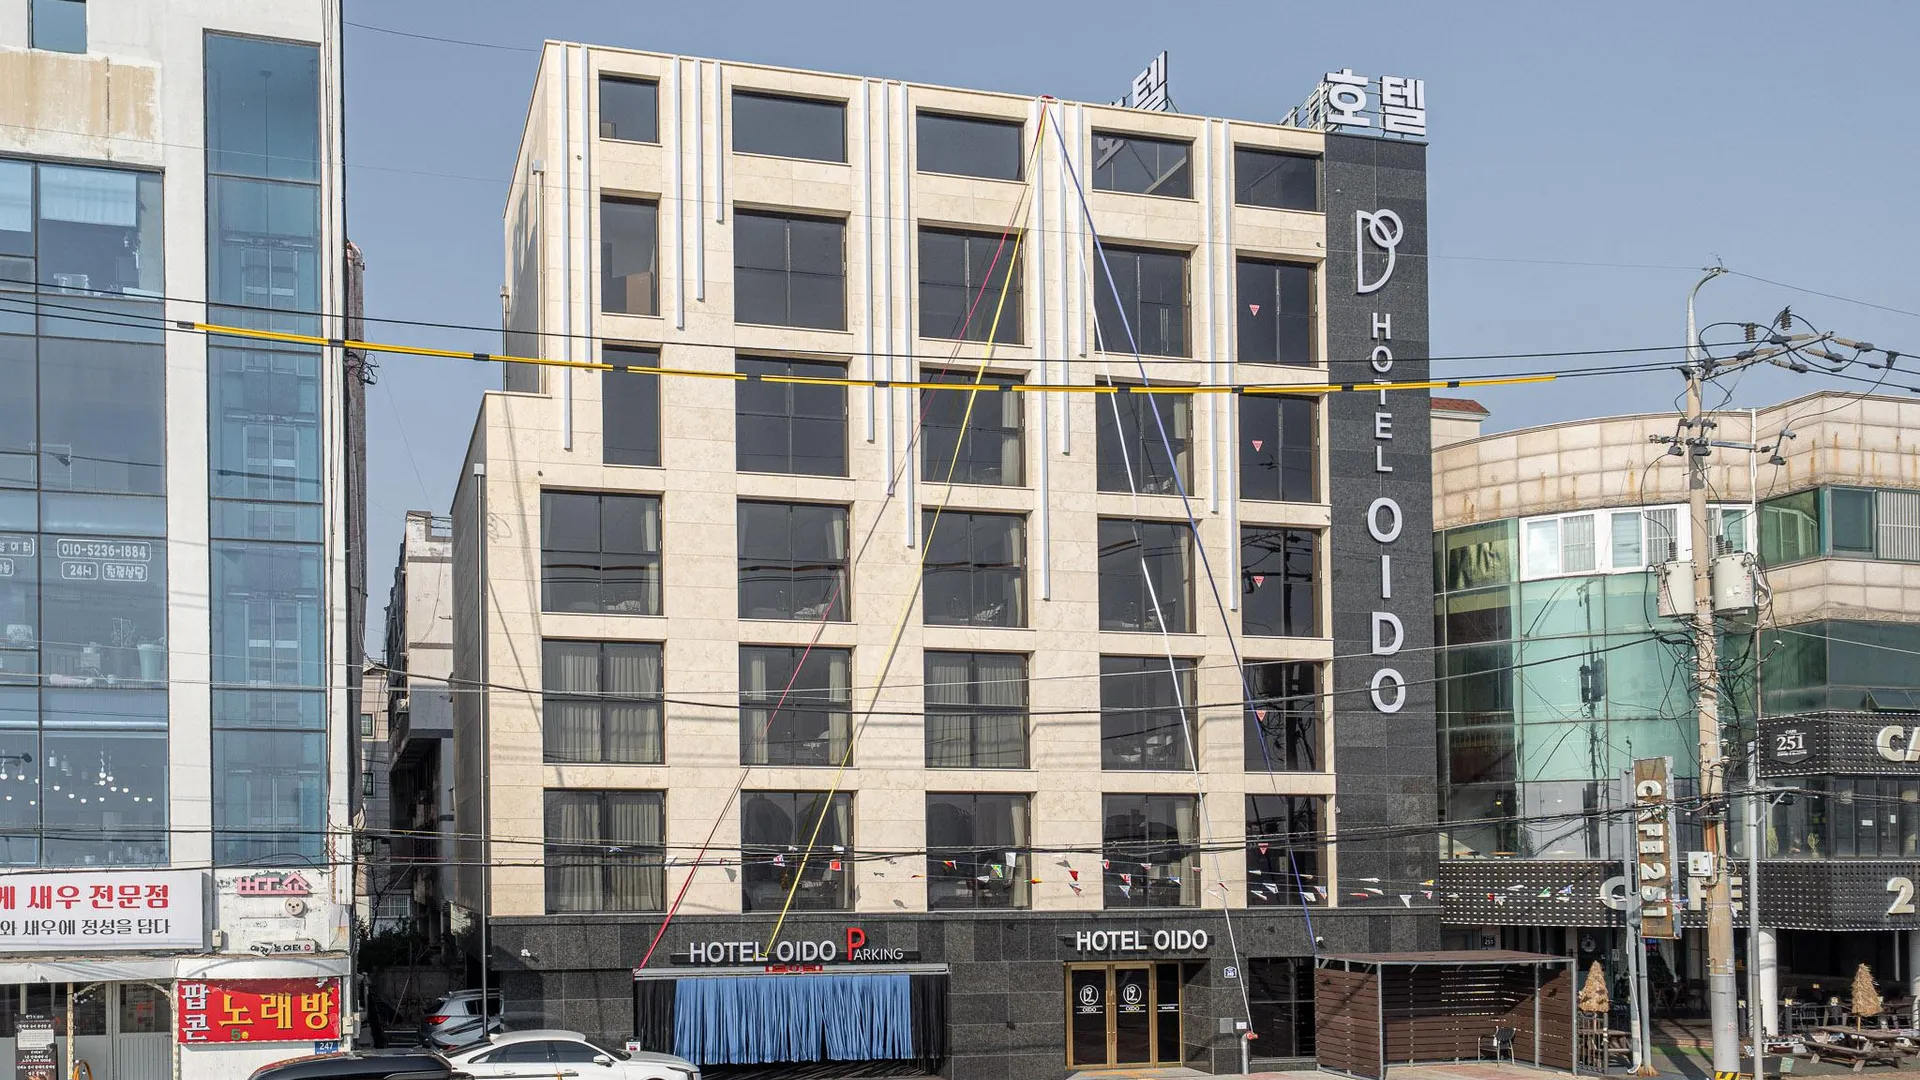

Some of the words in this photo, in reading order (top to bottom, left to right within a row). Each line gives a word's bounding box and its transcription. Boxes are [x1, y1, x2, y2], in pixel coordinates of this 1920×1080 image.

[1325, 69, 1426, 137] 호텔
[1371, 312, 1394, 473] HOTEL
[62, 543, 147, 559] 010-5236-1884
[1366, 497, 1407, 713] OIDO
[1776, 734, 1804, 751] 251
[27, 885, 81, 910] 새우
[89, 884, 169, 910] 전문점
[22, 919, 76, 936] 새우에
[82, 918, 132, 936] 정성을
[138, 918, 171, 934] 담다
[1076, 930, 1148, 951] HOTEL
[1154, 929, 1208, 950] OIDO
[689, 941, 768, 963] HOTEL
[777, 940, 836, 962] OIDO
[847, 927, 904, 961] PARKING
[181, 983, 211, 1041] 팝콘
[218, 992, 335, 1030] 노래방
[319, 1042, 334, 1050] 247
